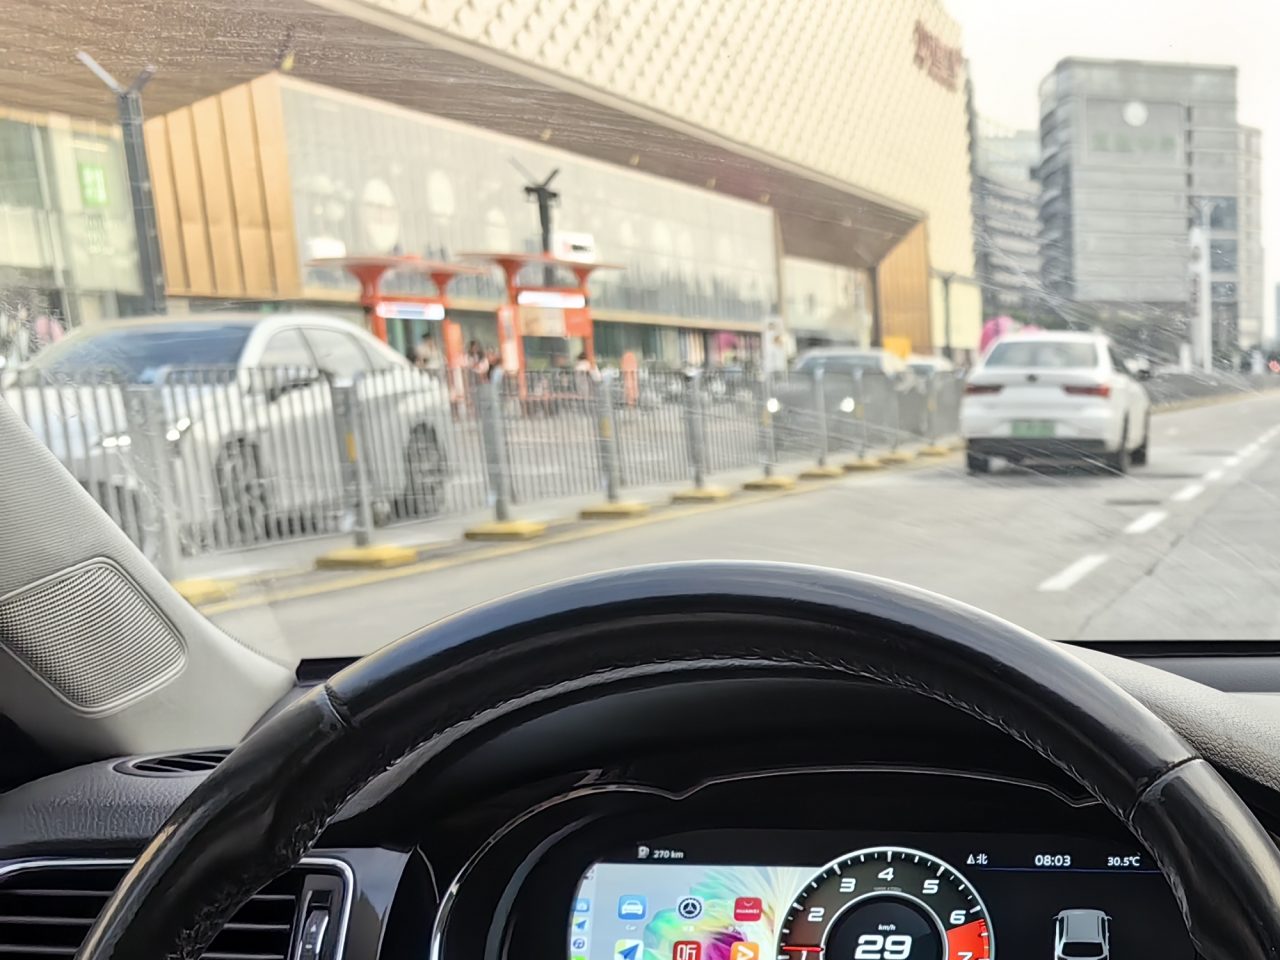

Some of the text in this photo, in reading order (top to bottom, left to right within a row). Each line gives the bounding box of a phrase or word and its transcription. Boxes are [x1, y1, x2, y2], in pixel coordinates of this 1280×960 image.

[671, 850, 684, 859] km
[1034, 854, 1071, 866] 08:03
[877, 867, 894, 882] 4
[839, 878, 856, 893] 3
[922, 879, 940, 894] 5
[807, 907, 825, 922] 2
[949, 910, 966, 924] 6
[877, 923, 896, 932] km/h
[854, 934, 912, 960] 29
